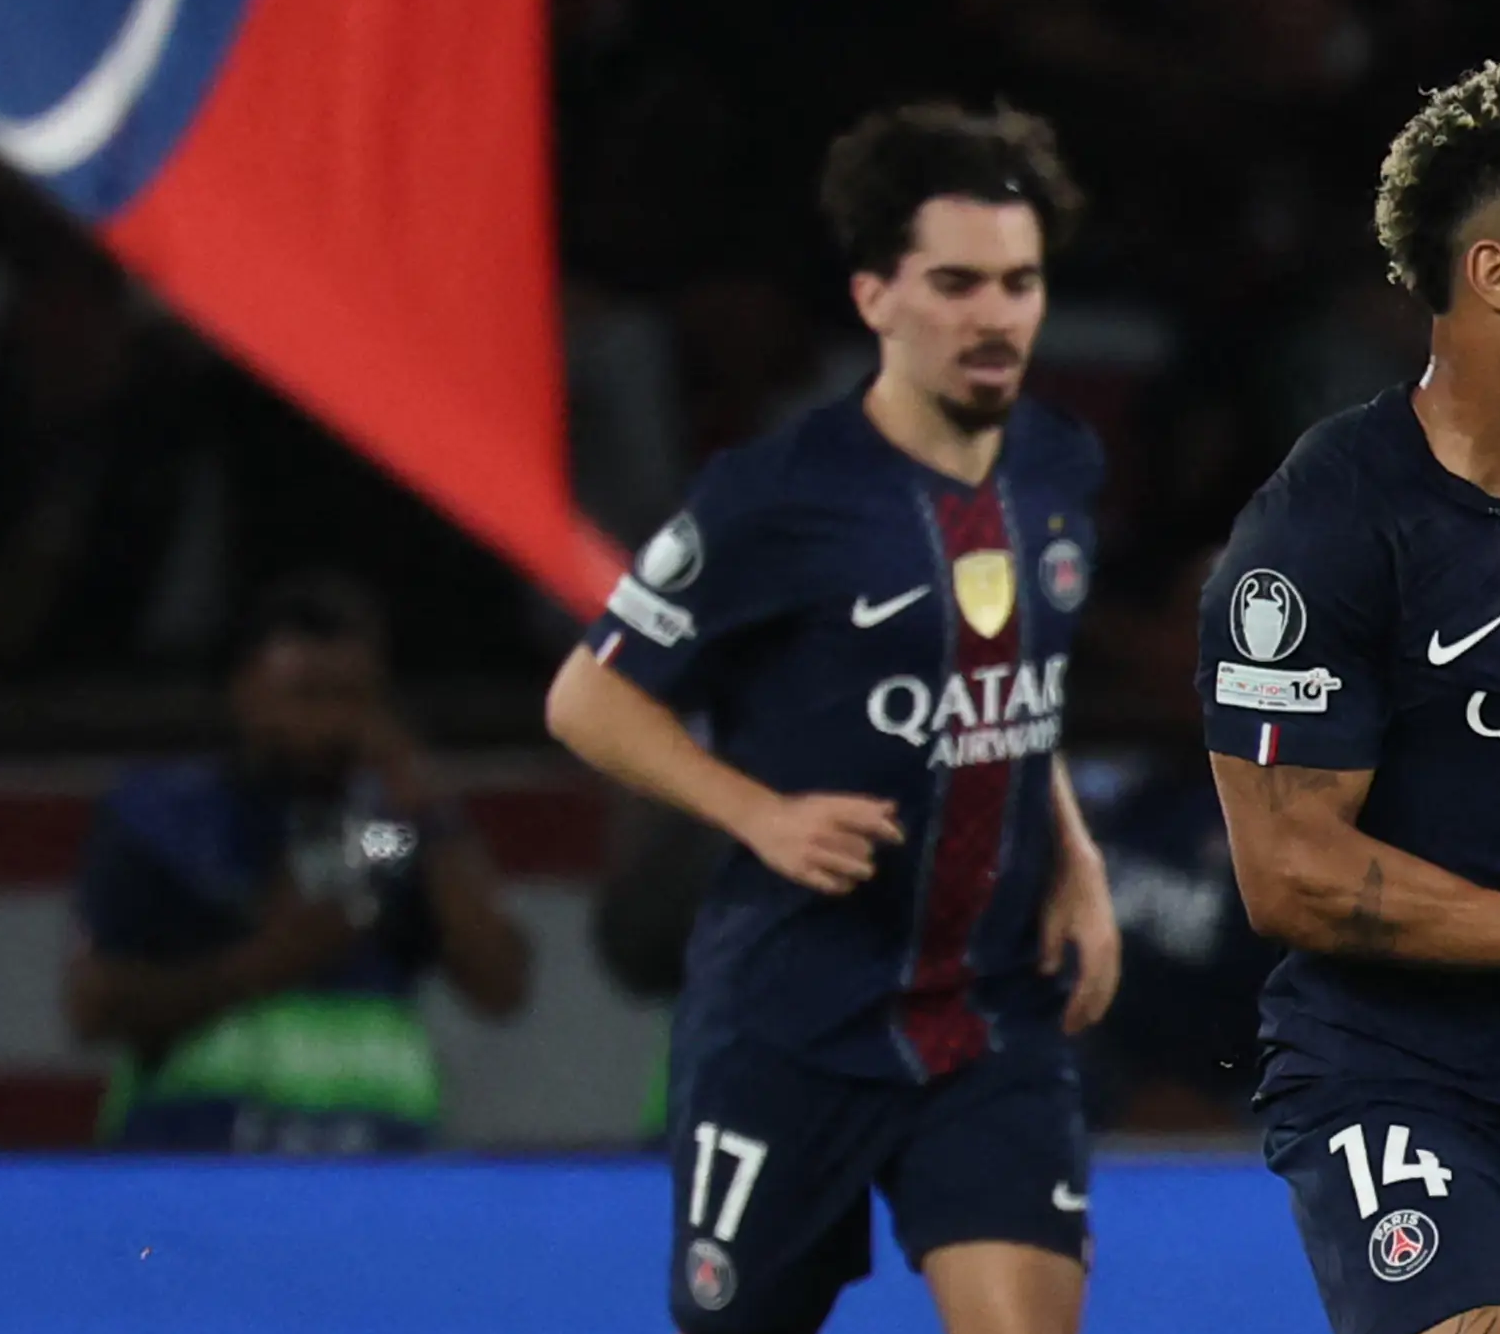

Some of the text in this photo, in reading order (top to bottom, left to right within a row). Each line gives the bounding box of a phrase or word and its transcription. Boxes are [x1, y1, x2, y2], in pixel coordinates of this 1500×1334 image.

[866, 652, 1068, 748] QATAR
[688, 1121, 768, 1242] 17
[1328, 1123, 1453, 1220] 14
